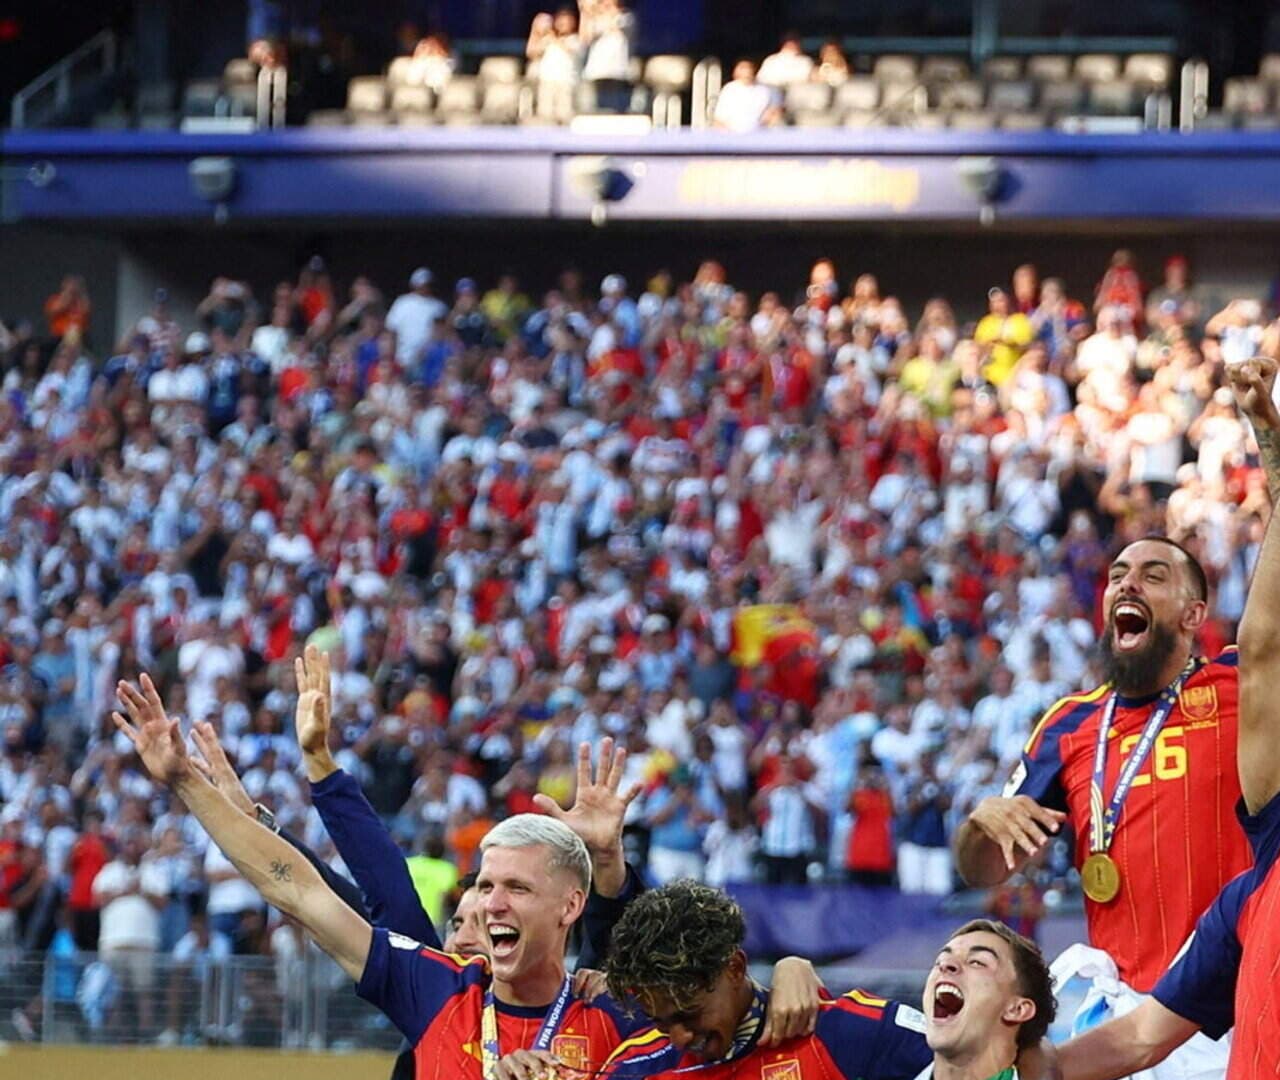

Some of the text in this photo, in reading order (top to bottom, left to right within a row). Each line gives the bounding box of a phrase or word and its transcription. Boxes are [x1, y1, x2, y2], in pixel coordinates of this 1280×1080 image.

[1120, 727, 1188, 787] 26
[1121, 753, 1141, 786] WORLD
[538, 1027, 554, 1049] FIFA
[548, 995, 566, 1030] WORLD
